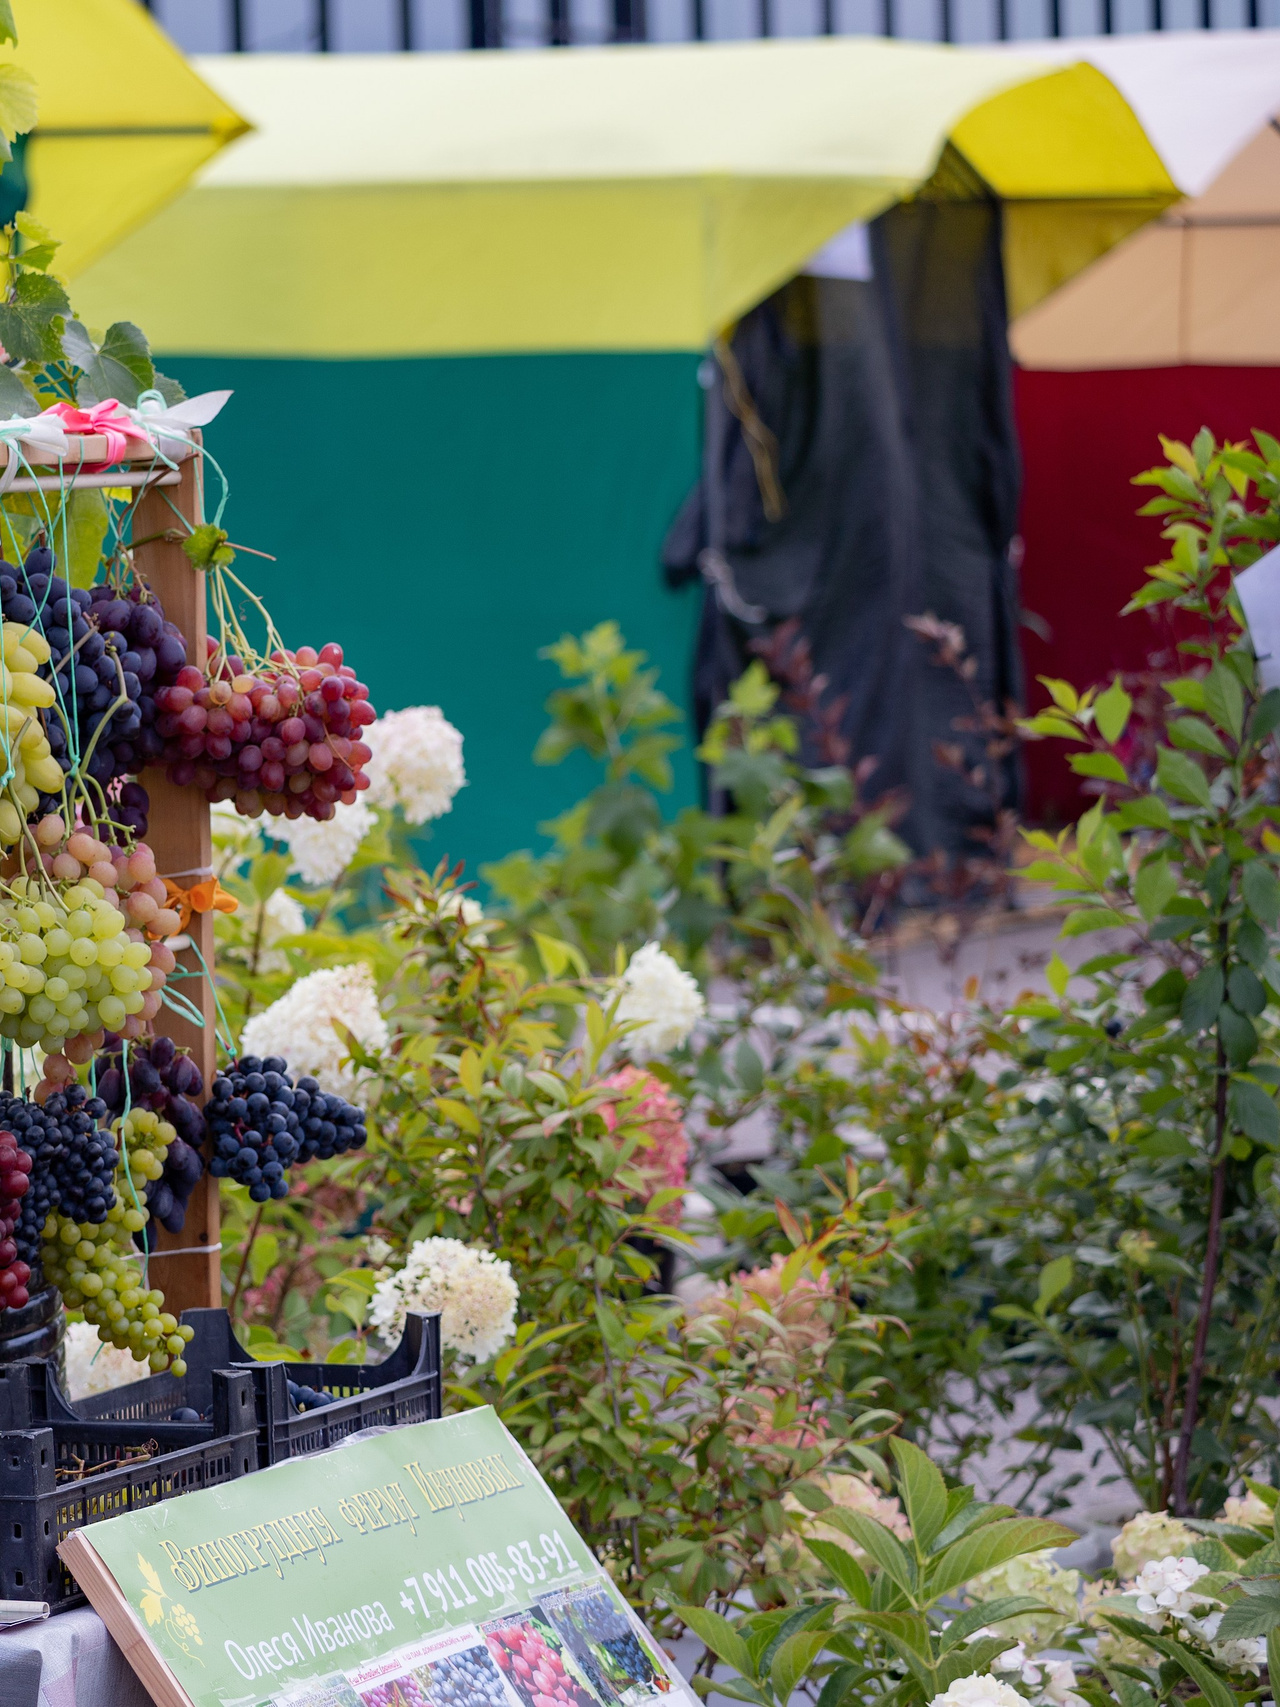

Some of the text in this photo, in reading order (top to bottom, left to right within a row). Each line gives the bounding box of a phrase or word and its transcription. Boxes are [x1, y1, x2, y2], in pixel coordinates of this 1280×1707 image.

[224, 1529, 579, 1680] Олеся Иванова +7 911 005-83-91
